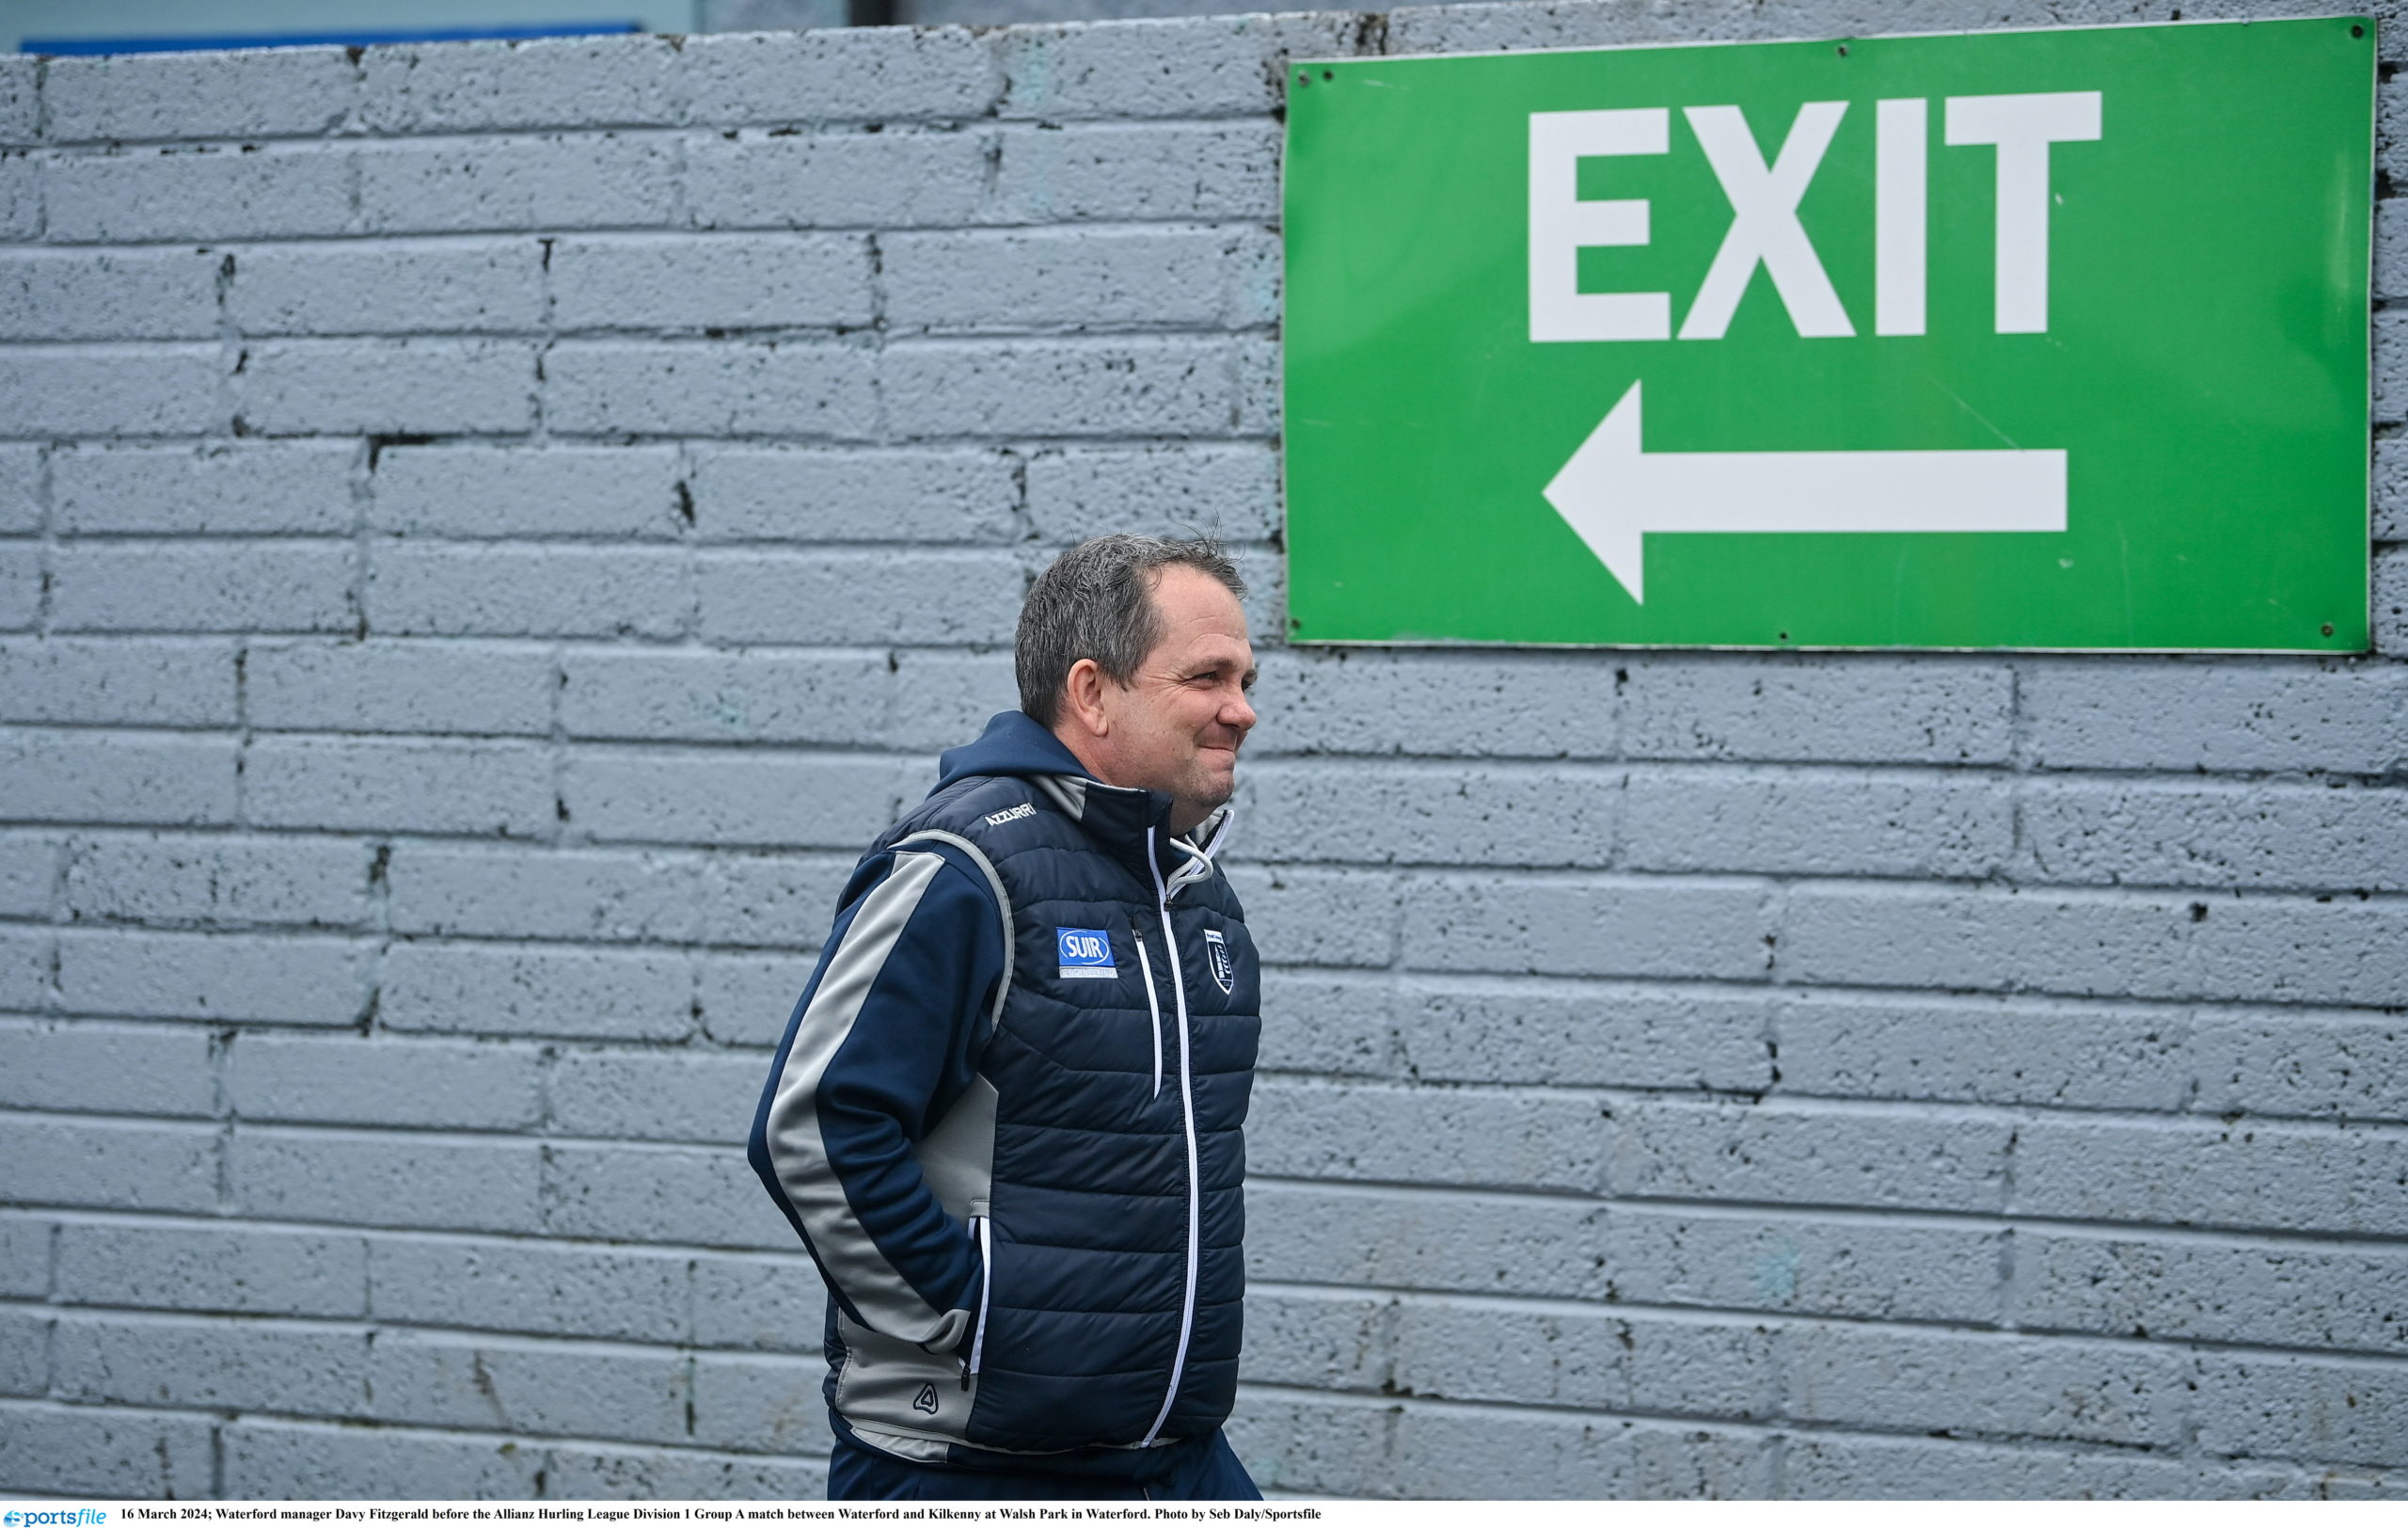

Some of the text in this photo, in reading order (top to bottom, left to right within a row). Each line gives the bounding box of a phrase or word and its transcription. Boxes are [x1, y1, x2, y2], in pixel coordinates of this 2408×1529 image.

[1529, 90, 2102, 342] EXIT
[984, 802, 1038, 826] AZZURRI
[1066, 935, 1104, 959] SUIR
